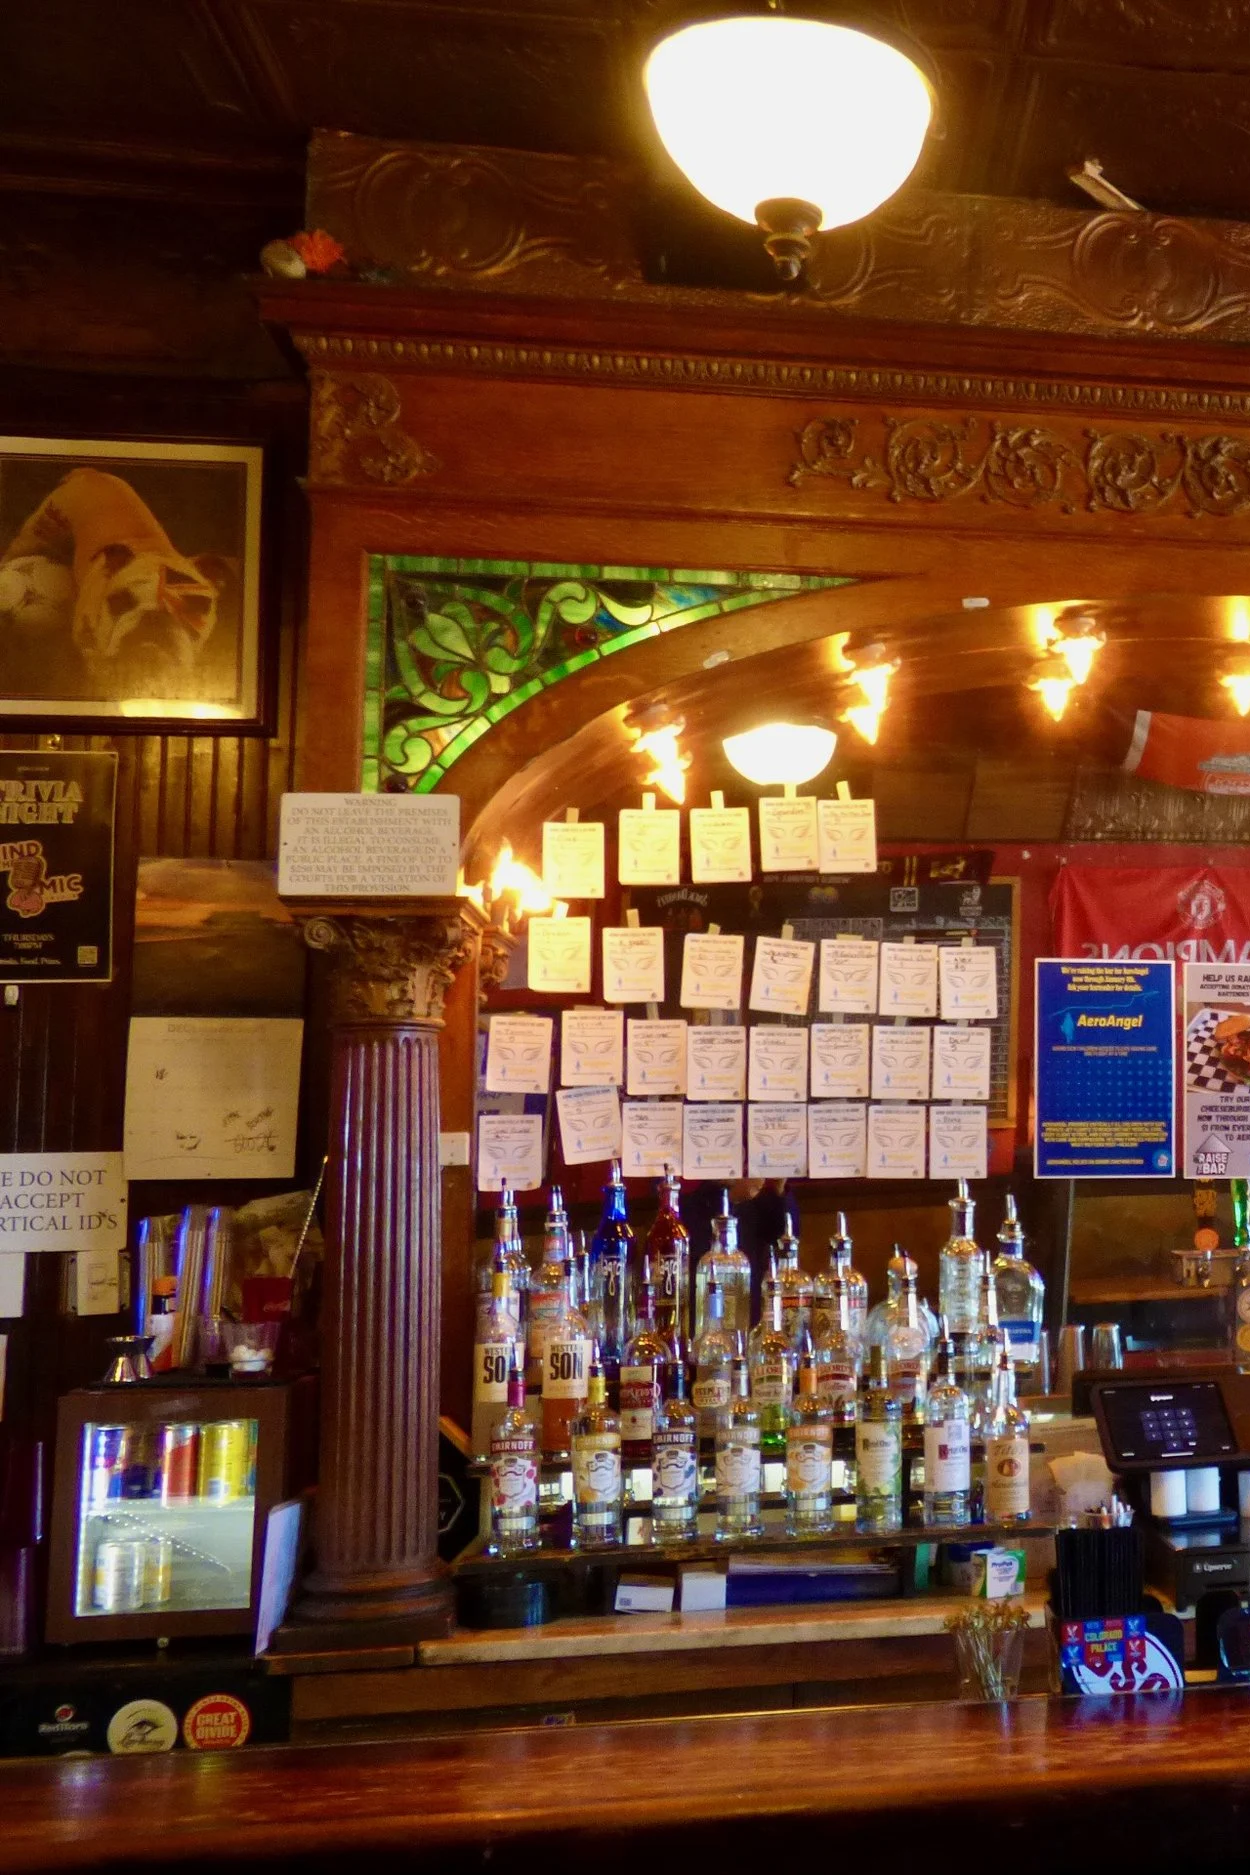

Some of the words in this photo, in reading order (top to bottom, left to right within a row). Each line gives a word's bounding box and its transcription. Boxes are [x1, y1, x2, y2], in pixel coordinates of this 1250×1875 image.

[343, 798, 397, 807] WARNING
[292, 807, 309, 817] DO
[310, 807, 336, 817] NOT
[338, 807, 370, 817] LEAVE
[374, 807, 394, 817] THE
[398, 807, 448, 817] PREMISES
[287, 817, 300, 827] OF
[305, 817, 329, 827] THIS
[331, 817, 418, 827] ESTABLISHMENT
[421, 817, 452, 827] WITH
[303, 827, 319, 836] AN
[323, 827, 373, 836] ALCOHOL
[323, 836, 366, 846] ILLEGAL
[370, 836, 386, 846] TO
[0, 840, 40, 860] IND
[292, 846, 308, 855] AN
[311, 846, 363, 855] ALCOHOL
[365, 846, 422, 855] BEVERAGE
[285, 855, 324, 865] PUBLIC
[377, 855, 402, 865] FINE
[403, 855, 417, 865] OF
[420, 855, 437, 865] UP
[438, 855, 452, 865] TO
[316, 865, 338, 874] MAY
[342, 865, 356, 874] BE
[357, 865, 407, 874] IMPOSED
[409, 865, 422, 874] BY
[289, 874, 334, 884] COURTS
[336, 874, 357, 884] FOR
[370, 874, 430, 884] VIOLATION
[432, 874, 448, 884] OF
[40, 876, 82, 894] MIC
[324, 884, 349, 893] THIS
[1202, 974, 1223, 983] HELP
[1225, 974, 1235, 983] US
[1077, 1014, 1143, 1030] AeroAngel
[1210, 1124, 1230, 1132] FROM
[1198, 1153, 1228, 1163] RAISE
[1202, 1163, 1226, 1175] BAR
[1, 1171, 13, 1187] E
[20, 1170, 53, 1187] DO
[60, 1169, 107, 1186] NOT
[0, 1192, 85, 1209] ACCEPT
[0, 1215, 73, 1232] RTICAL
[483, 1355, 506, 1384] SO
[549, 1352, 583, 1380] SON
[653, 1433, 695, 1444] SMIRNOFF
[1084, 1630, 1123, 1642] COLORADO
[1090, 1642, 1119, 1653] PALACE
[196, 1712, 237, 1725] GREAT
